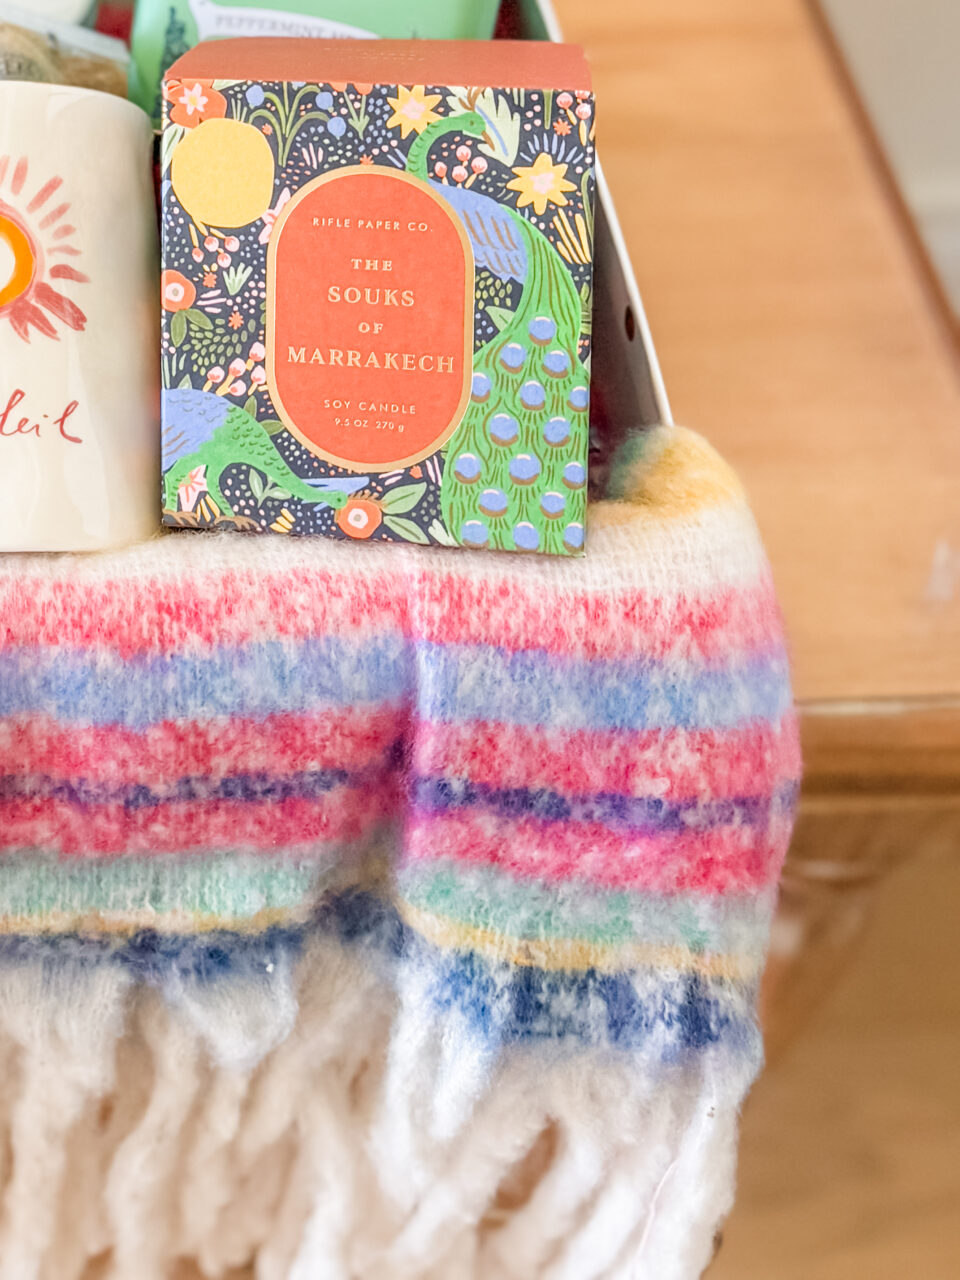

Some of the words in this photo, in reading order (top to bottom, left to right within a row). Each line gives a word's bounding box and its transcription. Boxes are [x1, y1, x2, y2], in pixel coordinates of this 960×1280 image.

[313, 217, 350, 228] RIFLE
[358, 219, 400, 231] PAPER
[408, 222, 433, 232] CO.
[351, 258, 393, 271] THE
[327, 285, 415, 307] SOUKS
[358, 322, 384, 334] OF
[287, 346, 454, 373] MARRAKECH
[323, 399, 351, 410] SOY
[358, 401, 417, 415] CANDLE
[335, 418, 351, 427] 9.5
[353, 419, 369, 428] OZ
[376, 421, 395, 431] 270
[398, 423, 405, 433] g
